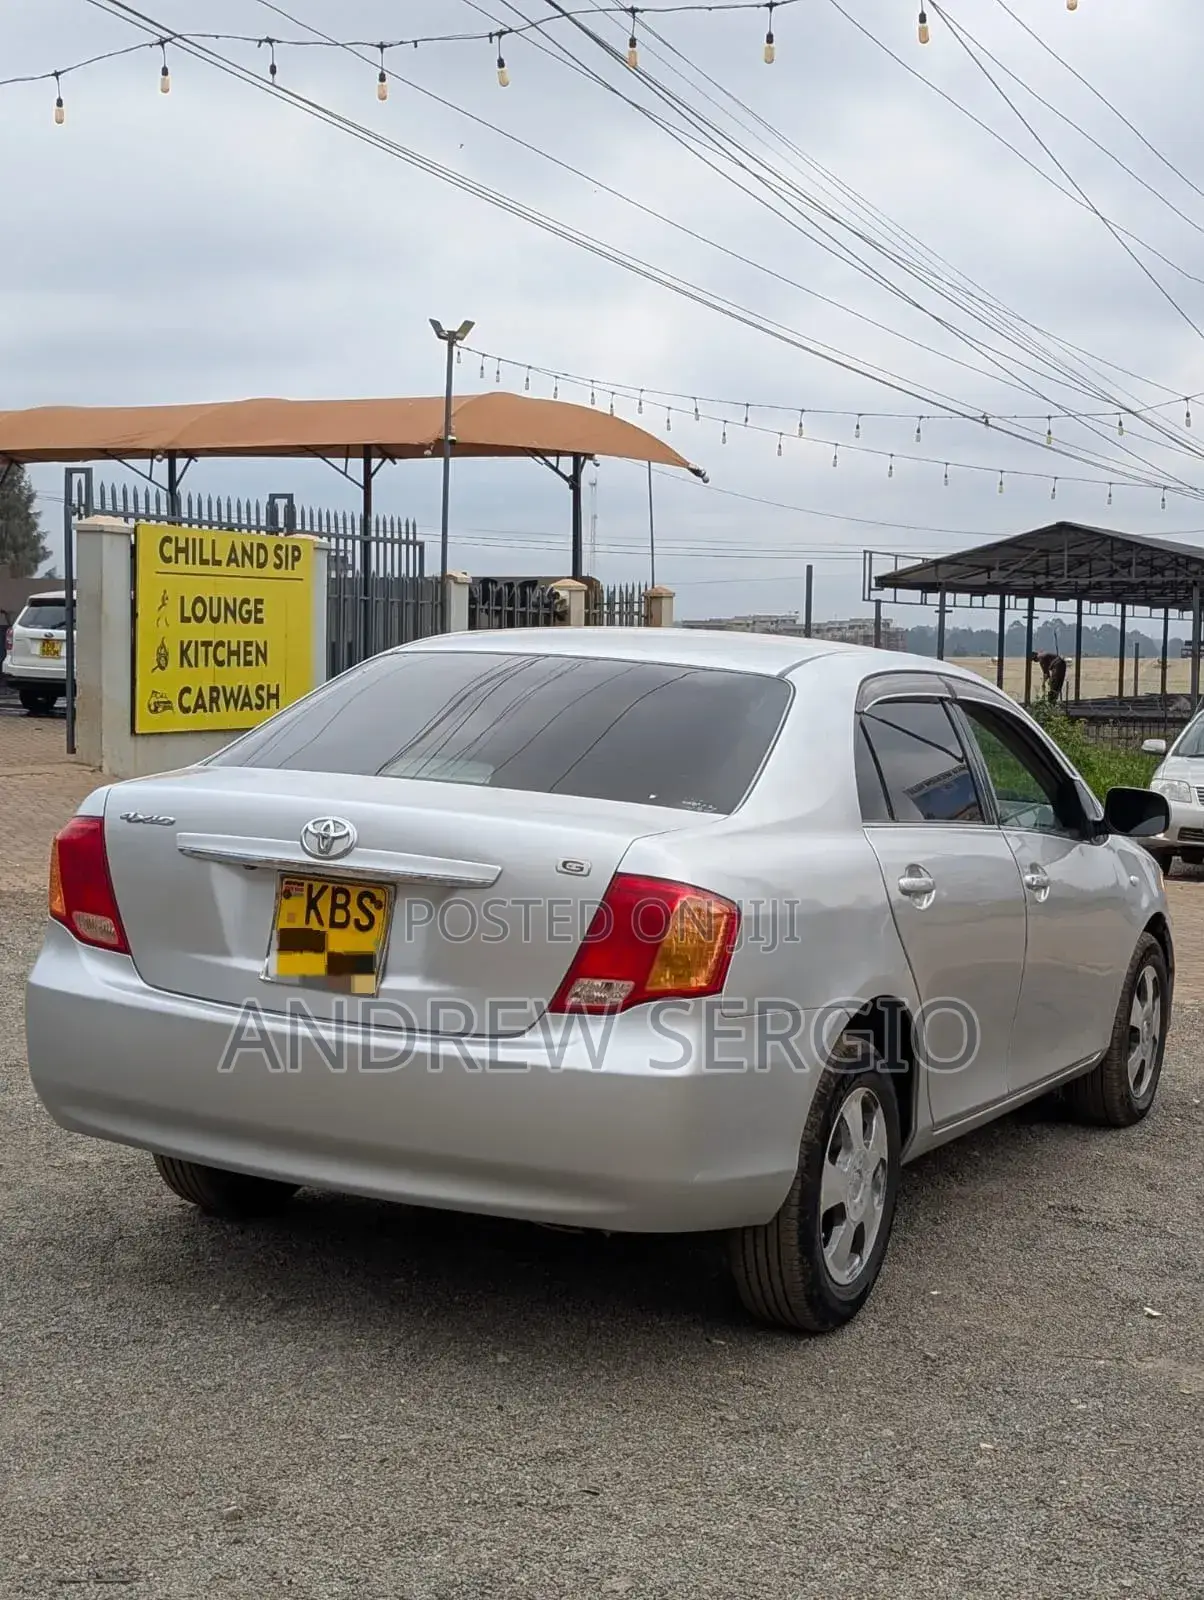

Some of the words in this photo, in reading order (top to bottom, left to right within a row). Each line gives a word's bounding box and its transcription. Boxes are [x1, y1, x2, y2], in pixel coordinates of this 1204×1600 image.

[159, 535, 222, 567] CHILL
[226, 540, 269, 569] AND
[273, 544, 302, 571] SIP
[180, 595, 265, 625] LOUNGE
[179, 639, 268, 668] KITCHEN
[177, 683, 280, 714] CARWASH
[561, 860, 585, 873] G
[304, 883, 377, 932] KBS
